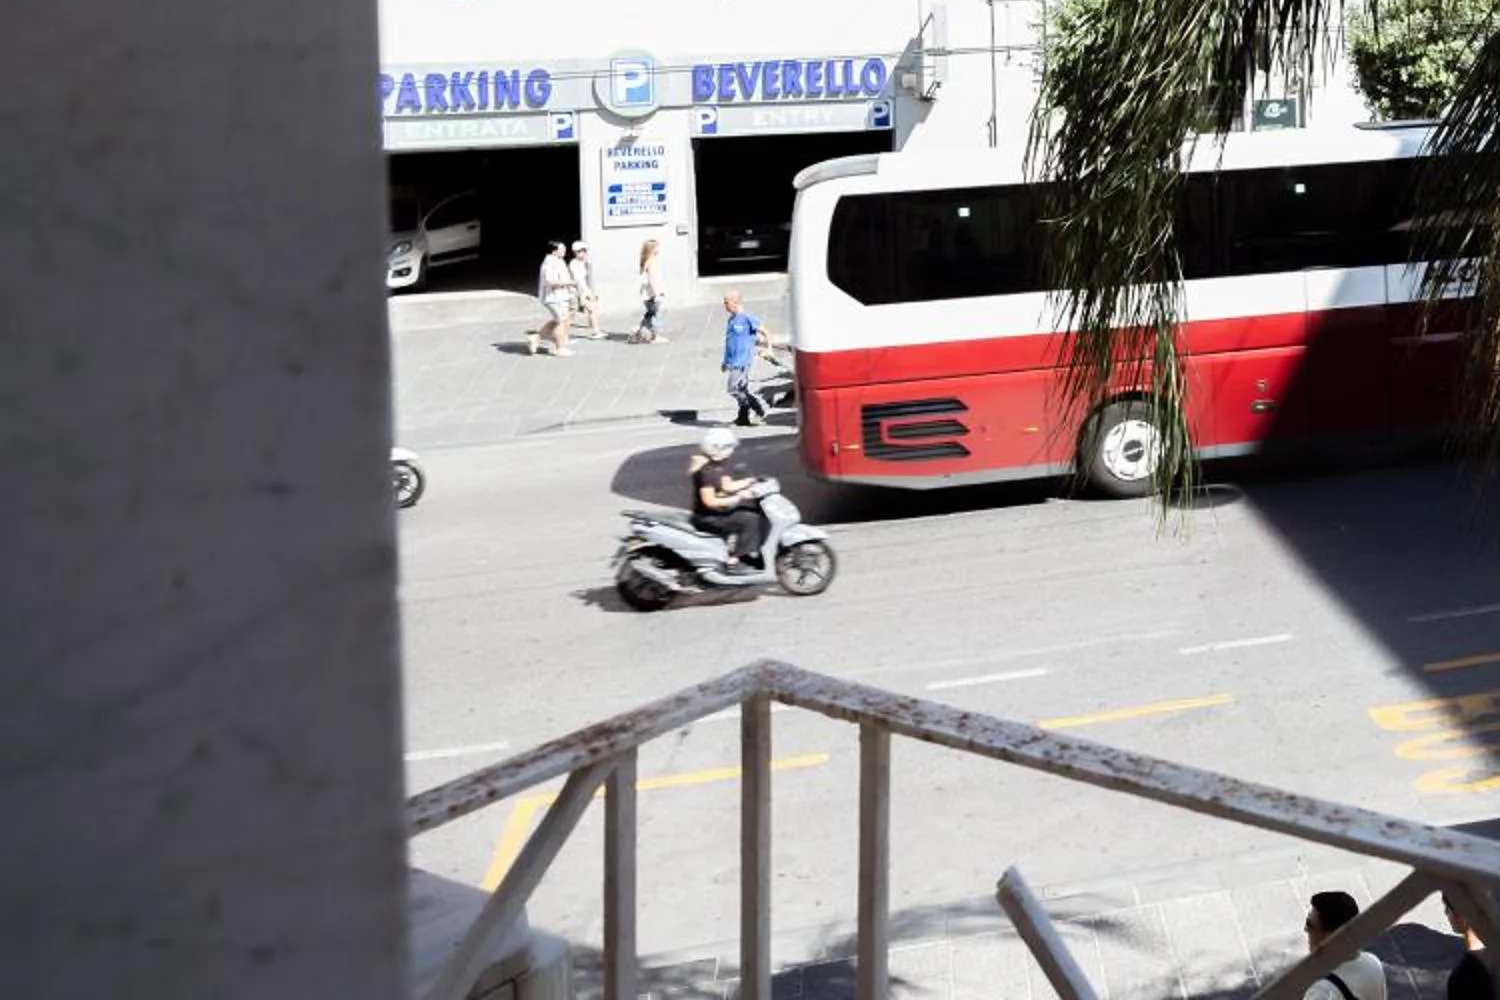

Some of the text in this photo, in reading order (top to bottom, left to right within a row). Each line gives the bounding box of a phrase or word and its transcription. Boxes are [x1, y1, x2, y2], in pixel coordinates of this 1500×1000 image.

[378, 68, 552, 114] PARKING
[616, 63, 649, 103] P
[692, 57, 887, 101] BEVERELLO
[553, 113, 573, 139] P
[697, 107, 717, 134] P
[754, 107, 835, 127] ENTRY
[873, 102, 889, 126] P
[403, 119, 528, 140] ENTRATA
[607, 145, 665, 158] BEVERELLO
[614, 159, 659, 171] PARKING
